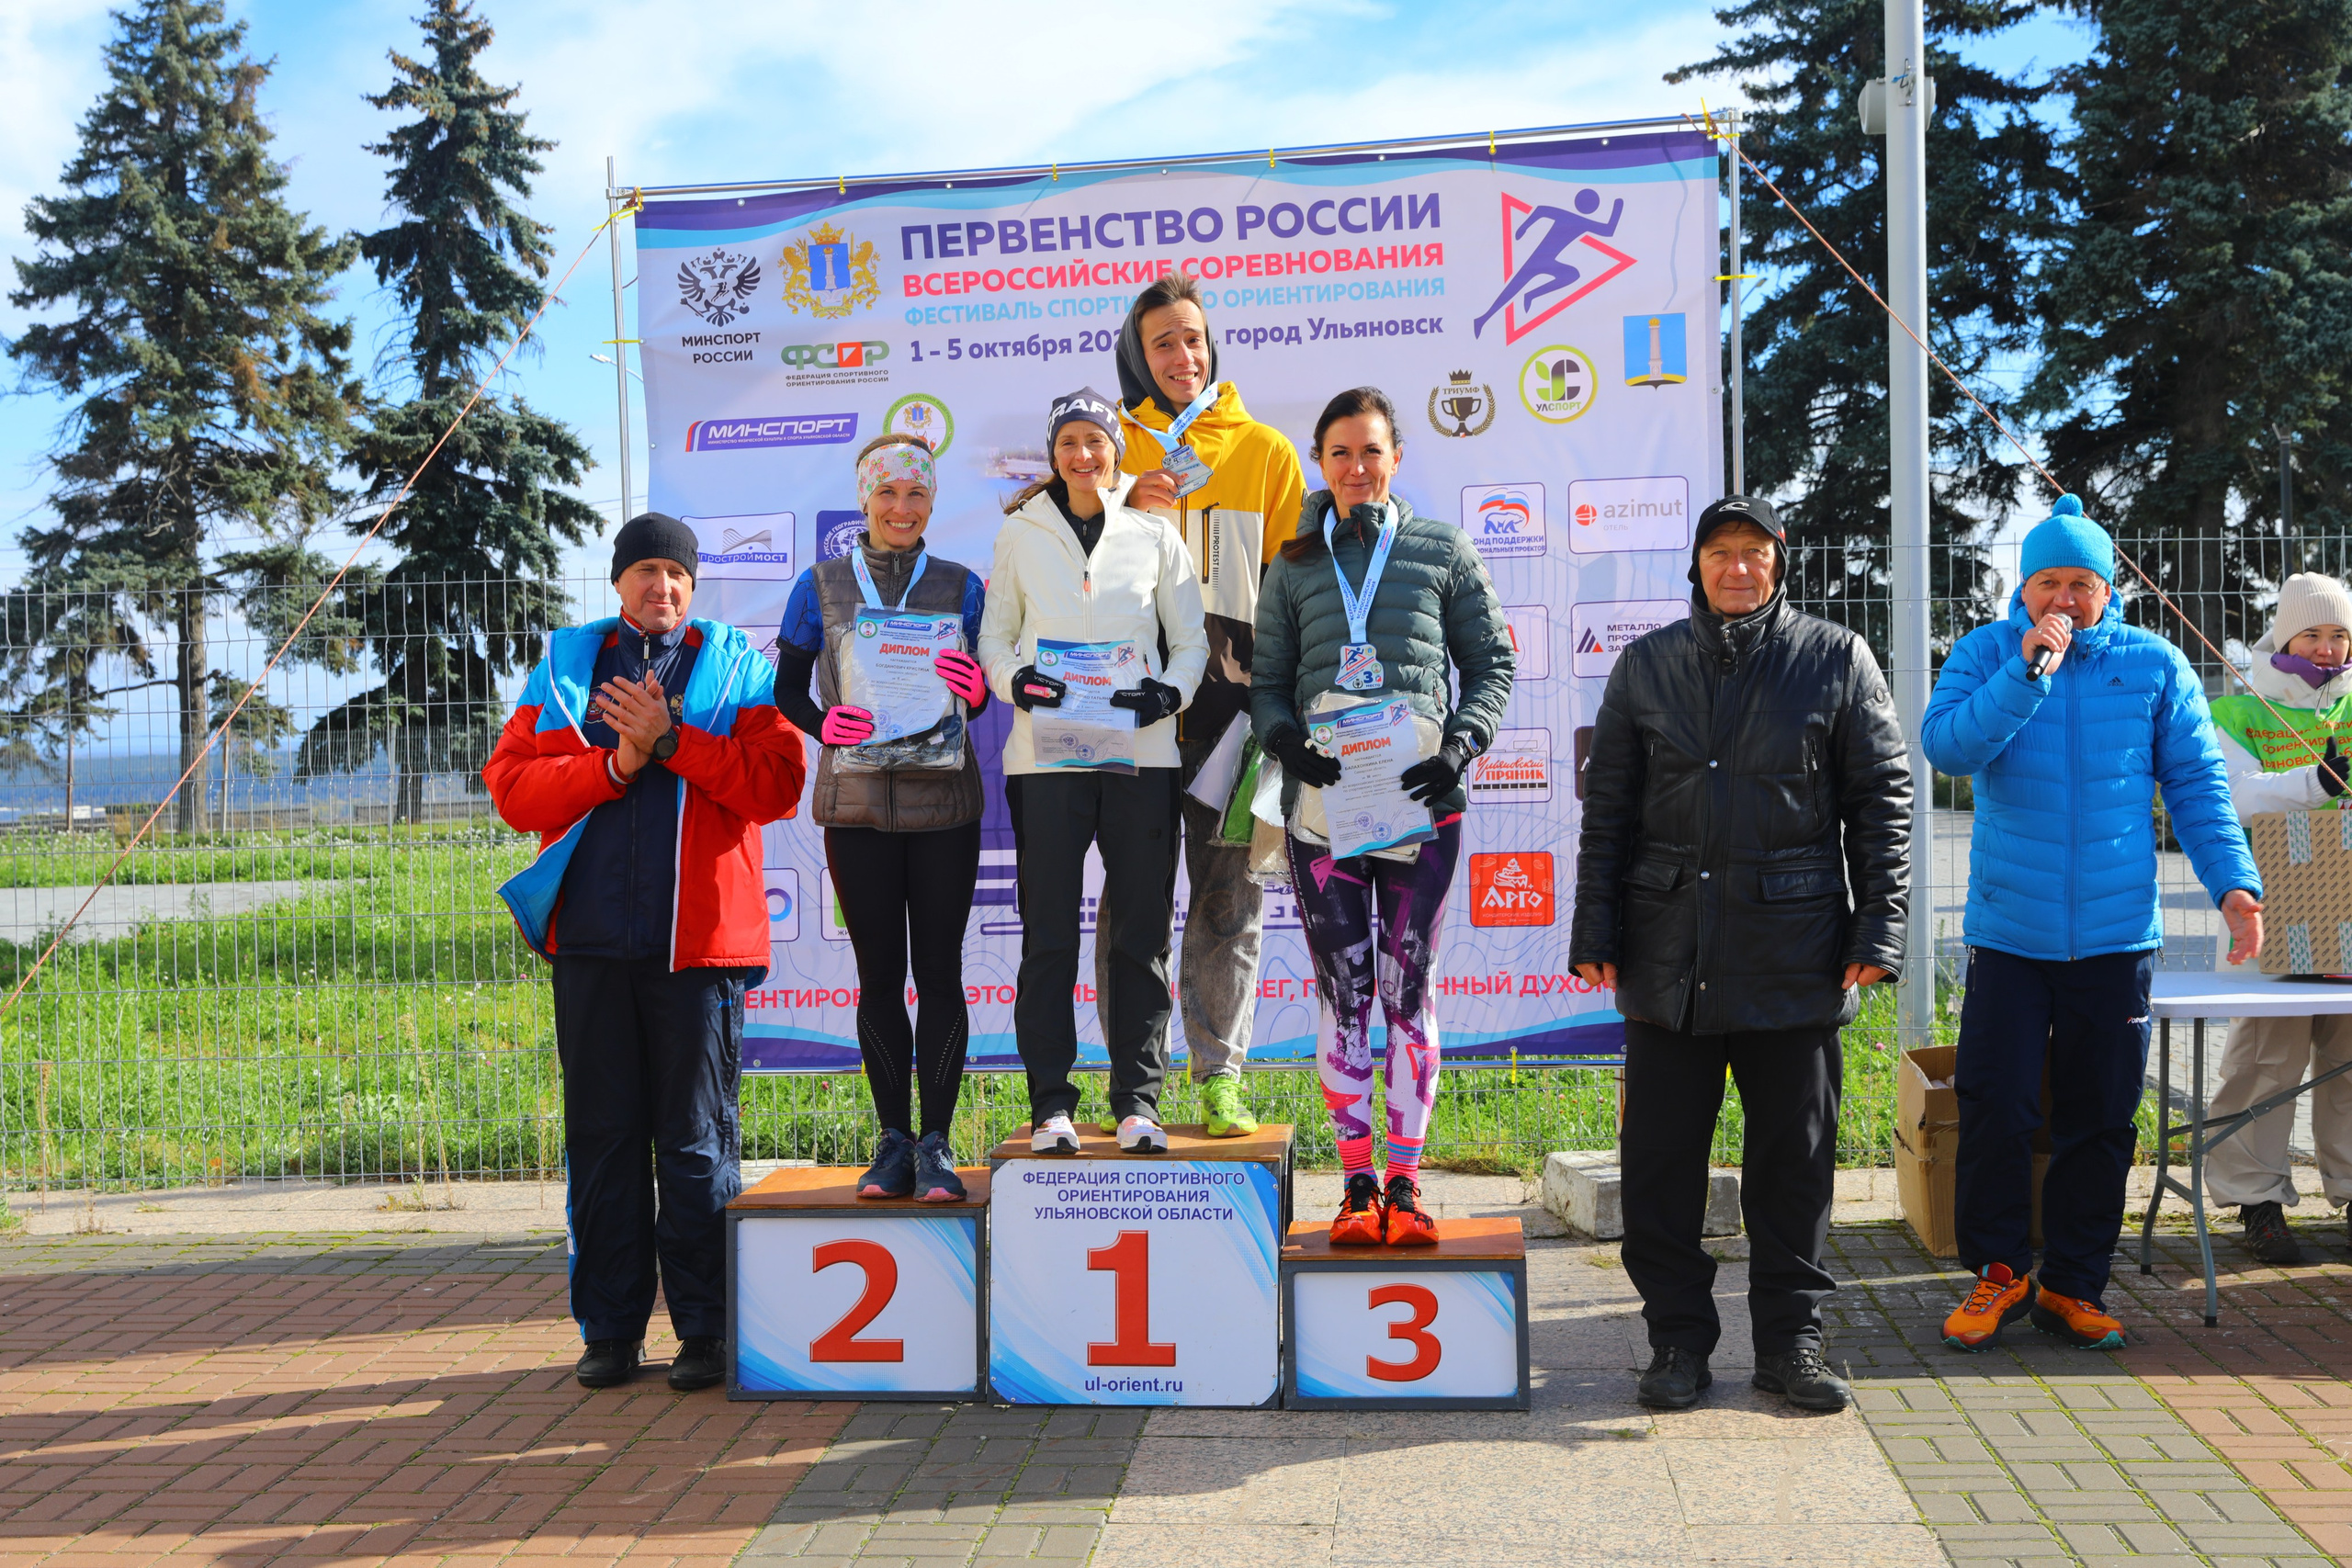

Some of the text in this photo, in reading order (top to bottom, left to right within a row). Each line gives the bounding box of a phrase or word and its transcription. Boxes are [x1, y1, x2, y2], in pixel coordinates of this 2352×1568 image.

[900, 192, 1442, 260] ПЕРВЕНСТВО РОССИИ
[903, 243, 1443, 298] ВСЕРОССИЙСКИЕ СОРЕВНОВАНИЯ
[904, 299, 1043, 326] ФЕСТИВАЛЬ
[1224, 277, 1445, 309] ОРИЕНТИРОВАНИЯ
[682, 332, 761, 347] МИНСПОРТ
[910, 340, 923, 362] 1
[947, 338, 963, 360] 5
[968, 333, 1072, 361] октября
[1226, 326, 1302, 349] город
[1307, 317, 1443, 341] Ульяновск
[693, 349, 753, 364] РОССИИ
[786, 369, 889, 380] ФЕДЕРАЦИЯ СПОРТИВНОГО
[786, 378, 856, 387] ОРИЕНТИРОВАНИЯ
[1442, 386, 1480, 395] ТРИУМФ
[1536, 400, 1581, 412] УЛСПОРТ
[708, 418, 852, 439] МИНСПОРТ
[1603, 499, 1683, 518] azimut
[1473, 535, 1544, 547] ОНД ПОДДЕРЖКИ
[1515, 545, 1546, 553] ПРОЕКТОВ
[1607, 623, 1661, 632] МЕТАЛЛО
[879, 643, 930, 657] ДИПЛОМ
[1034, 674, 1064, 688] VICTORY
[1063, 671, 1112, 686] ДИПЛОМ
[1363, 671, 1374, 683] 3
[1341, 737, 1392, 757] ДИПЛОМ
[1475, 755, 1544, 782] Ульяновский
[1486, 769, 1545, 781] ПРЯНИК
[1023, 1171, 1245, 1187] ФЕДЕРАЦИЯ СПОРТИВНОГО
[1057, 1190, 1210, 1202] ОРИЕНТИРОВАНИЯ
[1035, 1205, 1234, 1221] УЛЬЯНОВСКОЙ ОБЛАСТИ
[809, 1238, 903, 1362] 2
[1087, 1229, 1176, 1367] 1
[1366, 1282, 1442, 1382] 3
[1085, 1376, 1182, 1393] ul-orient.ru
